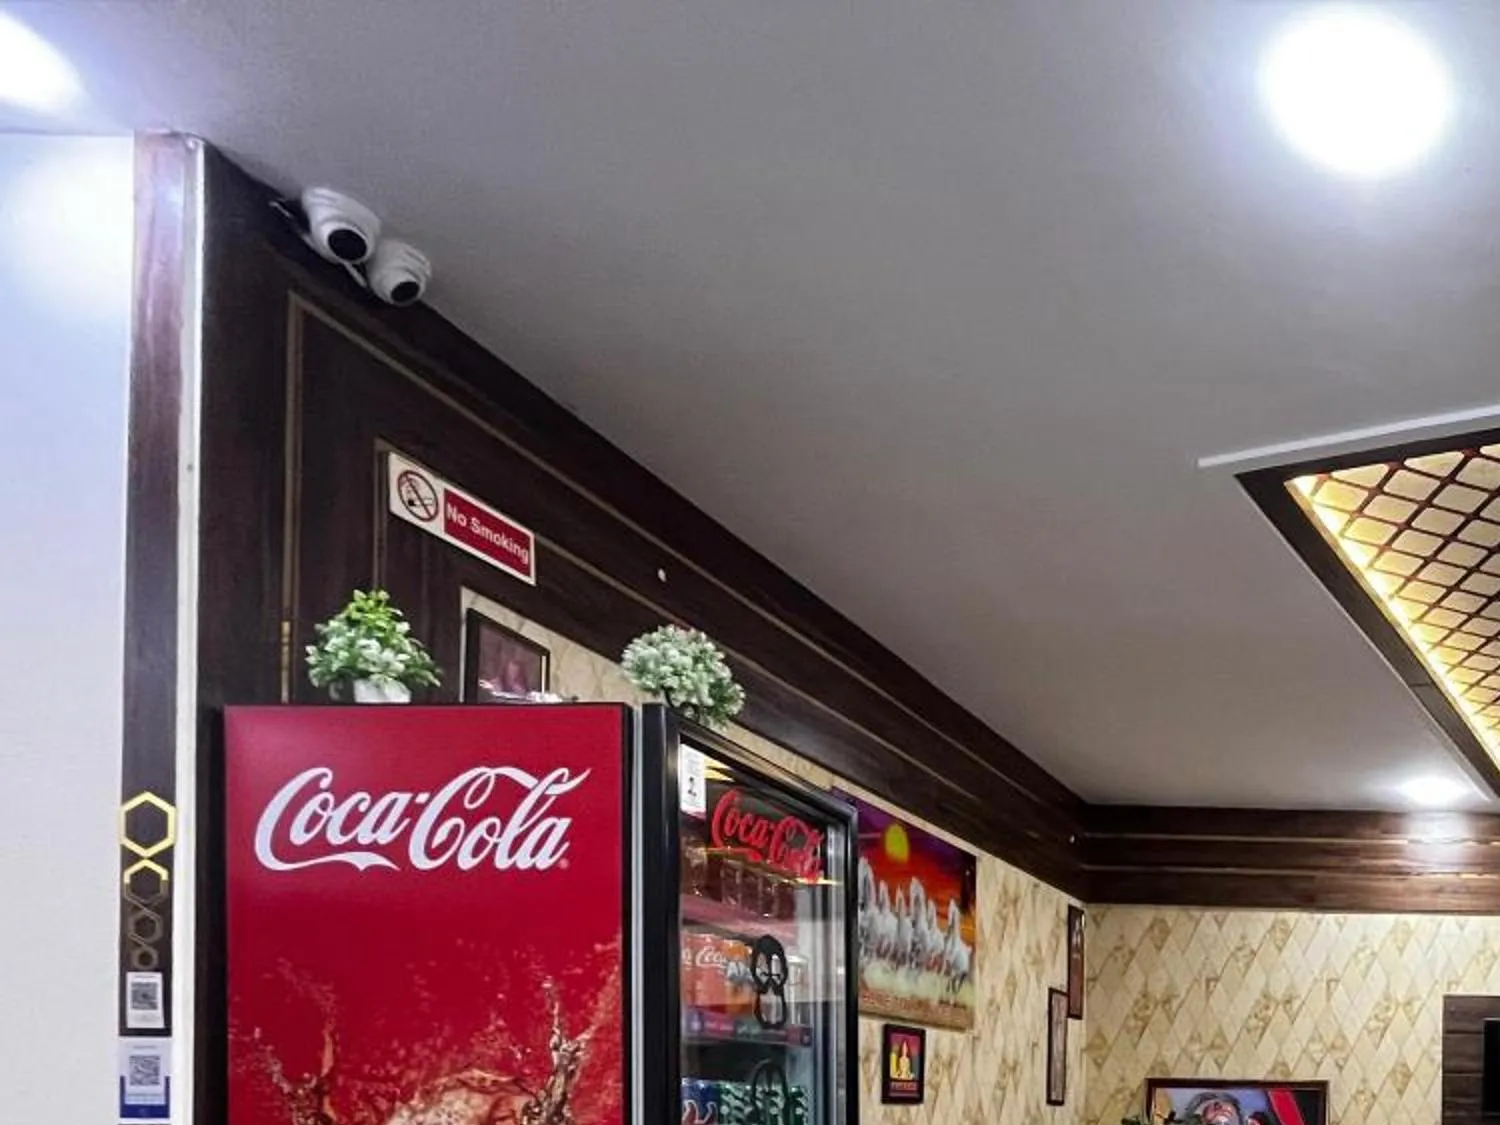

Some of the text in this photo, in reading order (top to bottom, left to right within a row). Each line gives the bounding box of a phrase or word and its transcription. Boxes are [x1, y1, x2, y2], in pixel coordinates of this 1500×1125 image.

[447, 502, 530, 565] No Smoking
[254, 765, 592, 871] Coca-Cola
